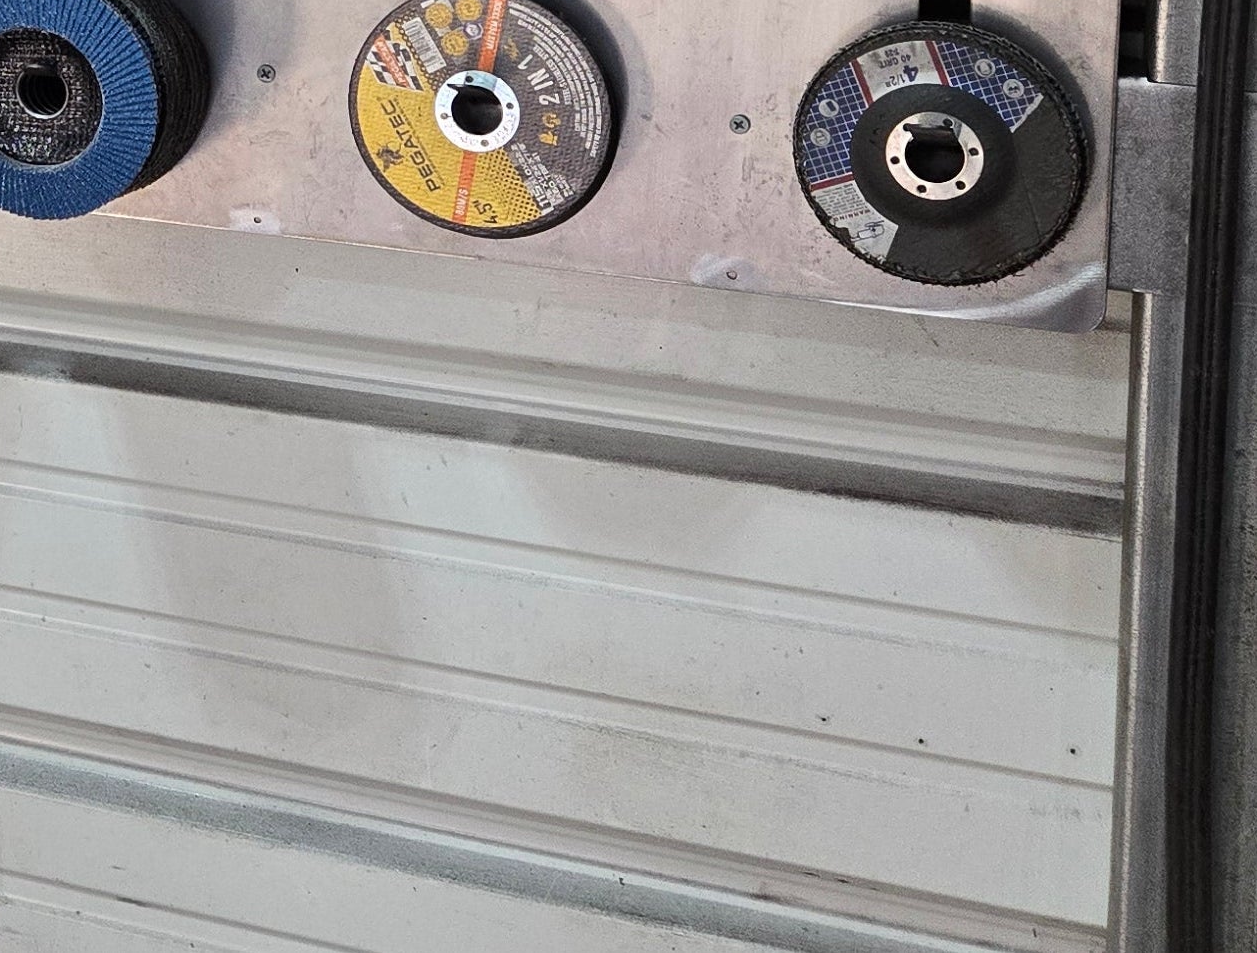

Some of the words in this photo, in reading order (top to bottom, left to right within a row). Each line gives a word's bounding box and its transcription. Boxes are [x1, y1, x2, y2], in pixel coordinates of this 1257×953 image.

[516, 53, 536, 70] 1
[527, 67, 554, 93] IN
[901, 64, 920, 83] 4
[537, 87, 562, 110] 2
[380, 97, 442, 194] PEGATEC
